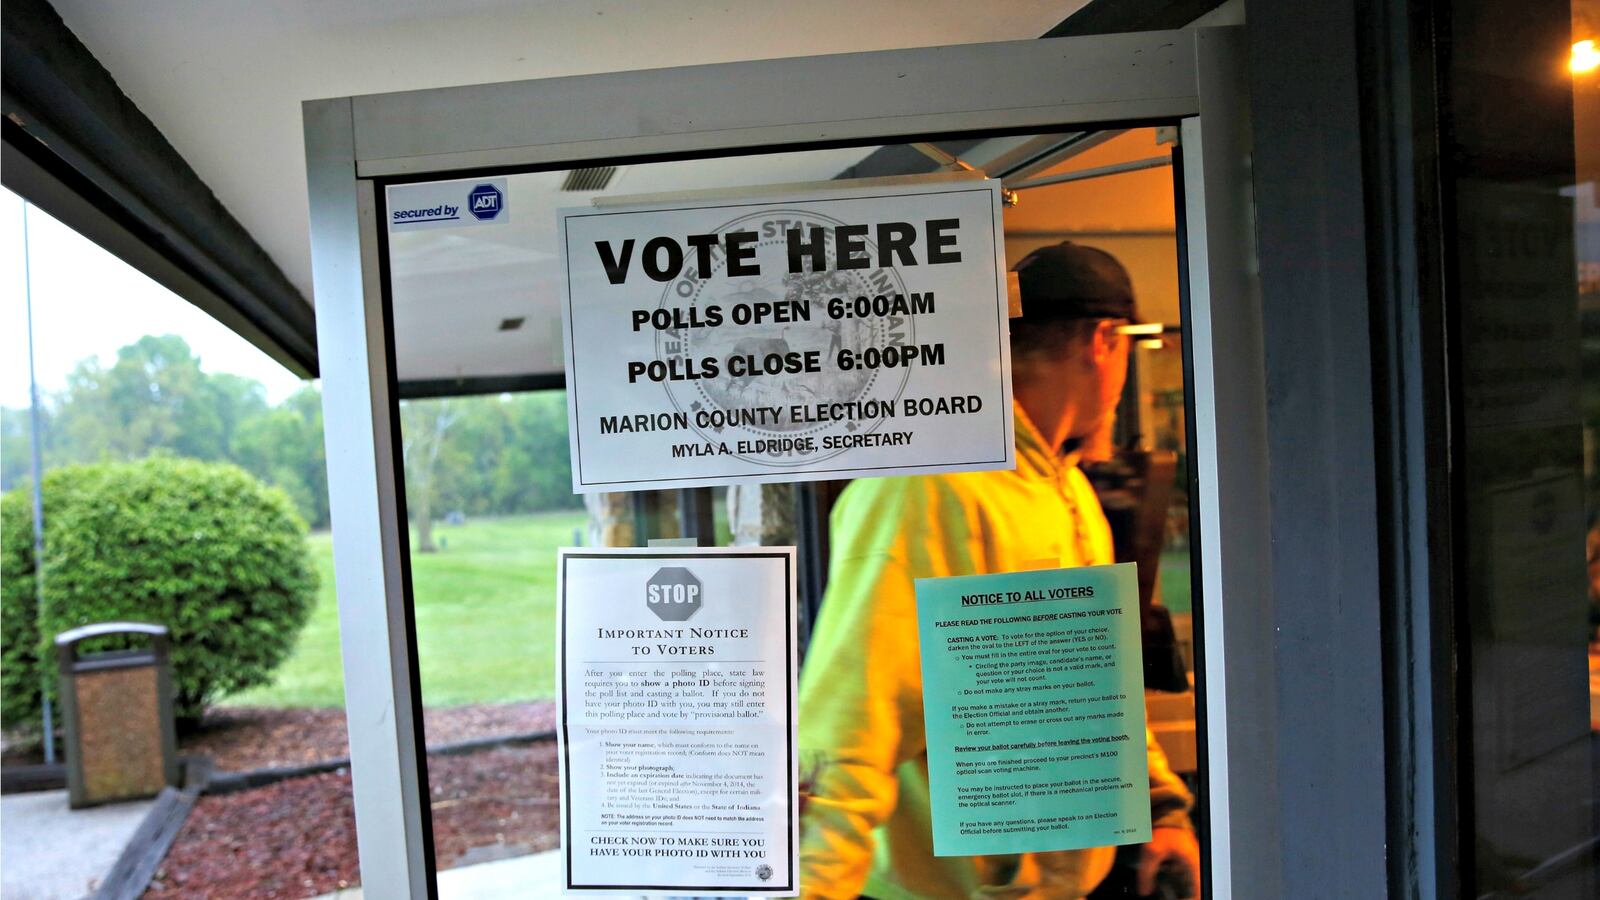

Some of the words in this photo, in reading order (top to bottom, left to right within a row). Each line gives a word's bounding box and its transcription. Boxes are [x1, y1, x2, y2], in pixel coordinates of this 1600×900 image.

[474, 195, 497, 208] ADT
[393, 205, 442, 219] secured
[444, 204, 459, 217] by
[595, 231, 761, 285] VOTE
[787, 218, 962, 274] HERE
[632, 305, 723, 332] POLLS
[732, 300, 810, 325] OPEN
[827, 292, 935, 320] 6:00AM
[628, 357, 719, 383] POLLS
[727, 351, 821, 377] CLOSE
[837, 343, 945, 371] 6:00PM
[600, 412, 688, 434] MARION
[696, 406, 783, 429] COUNTY
[790, 400, 895, 423] ELECTION
[904, 395, 982, 417] BOARD
[672, 443, 714, 458] MYLA
[718, 442, 733, 455] A.
[737, 437, 818, 454] ELDRIDGE,
[823, 432, 913, 449] SECRETARY
[648, 583, 700, 604] STOP
[961, 593, 1004, 606] NOTICE
[1005, 591, 1022, 602] TO
[1024, 590, 1046, 601] ALL
[1048, 586, 1094, 599] VOTERS
[935, 620, 960, 628] PLEASE
[960, 619, 979, 627] READ
[993, 615, 1032, 624] FOLLOWING
[1032, 613, 1058, 622] BEFORE
[1059, 611, 1087, 620] CASTING
[1087, 609, 1105, 617] YOUR
[598, 628, 684, 639] IMPORTANT
[690, 628, 748, 638] NOTICE
[947, 636, 975, 644] CASTING
[632, 646, 651, 655] TO
[657, 644, 715, 655] VOTERS
[981, 642, 995, 650] oval
[1038, 648, 1051, 656] oval
[1061, 647, 1075, 655] your
[584, 669, 604, 677] After
[609, 671, 623, 679] you
[653, 669, 665, 677] the
[671, 669, 697, 679] polling
[752, 668, 765, 677] law
[640, 679, 661, 687] show
[672, 679, 696, 689] photo
[699, 679, 710, 687] ID
[713, 679, 737, 687] before
[739, 679, 765, 689] signing
[584, 689, 597, 697] the
[599, 689, 614, 699] poll
[616, 689, 627, 697] list
[630, 689, 644, 698] and
[646, 691, 673, 699] casting
[712, 689, 720, 697] If
[739, 689, 750, 697] do
[585, 698, 602, 707] have
[623, 699, 645, 709] photo
[647, 700, 658, 708] ID
[660, 698, 677, 708] with
[731, 699, 744, 708] still
[585, 710, 598, 718] this
[600, 709, 625, 719] polling
[626, 710, 646, 719] place
[646, 710, 661, 718] and
[679, 709, 689, 719] by
[997, 758, 1022, 766] finished
[1023, 756, 1048, 765] proceed
[1100, 750, 1118, 758] M100
[591, 836, 629, 845] CHECK
[631, 837, 657, 845] NOW
[659, 837, 675, 845] TO
[678, 838, 709, 846] MAKE
[711, 838, 740, 847] SURE
[742, 839, 765, 847] YOU
[590, 848, 619, 856] HAVE
[622, 848, 652, 857] YOUR
[655, 849, 693, 857] PHOTO
[696, 849, 708, 858] ID
[710, 850, 740, 858] WITH
[743, 850, 766, 858] YOU
